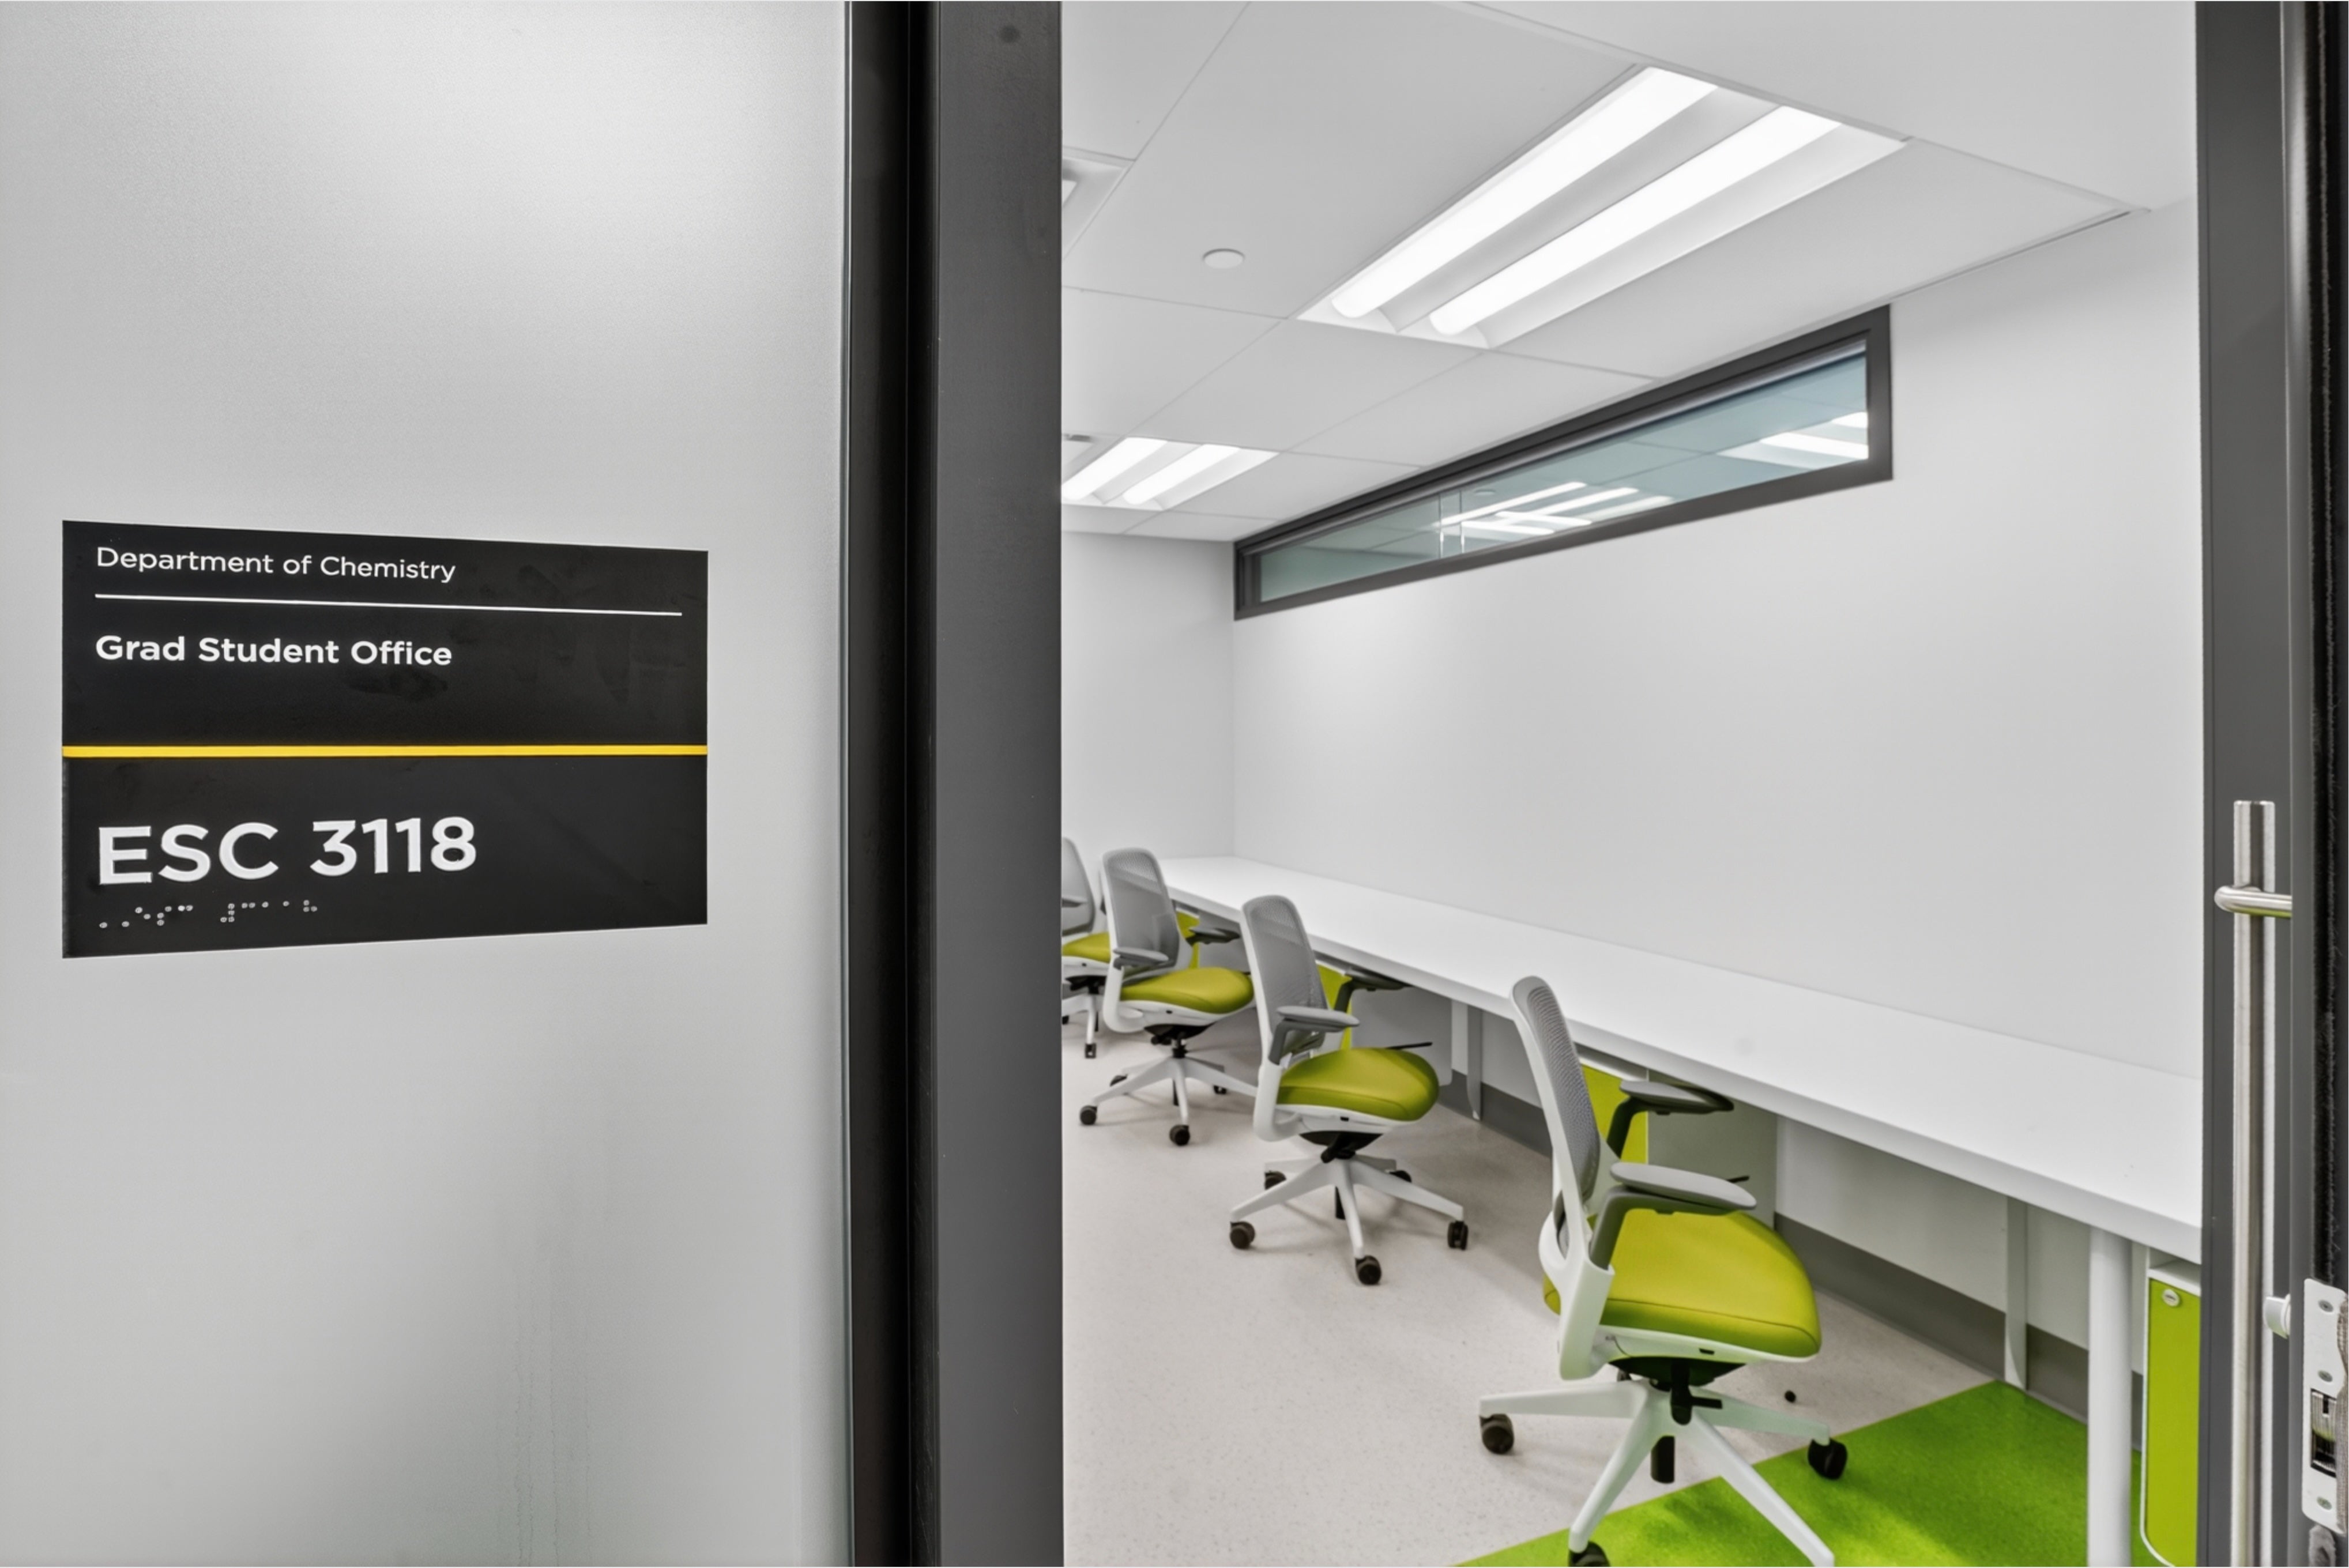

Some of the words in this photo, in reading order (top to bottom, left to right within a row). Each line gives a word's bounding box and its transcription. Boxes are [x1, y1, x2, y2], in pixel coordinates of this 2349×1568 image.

[97, 546, 274, 574] Department
[283, 555, 312, 575] of
[320, 556, 456, 583] Chemistry
[96, 635, 185, 661] Grad
[198, 637, 340, 664] Student
[351, 640, 452, 666] Office
[98, 821, 279, 885] ESC
[310, 816, 476, 877] 3118
